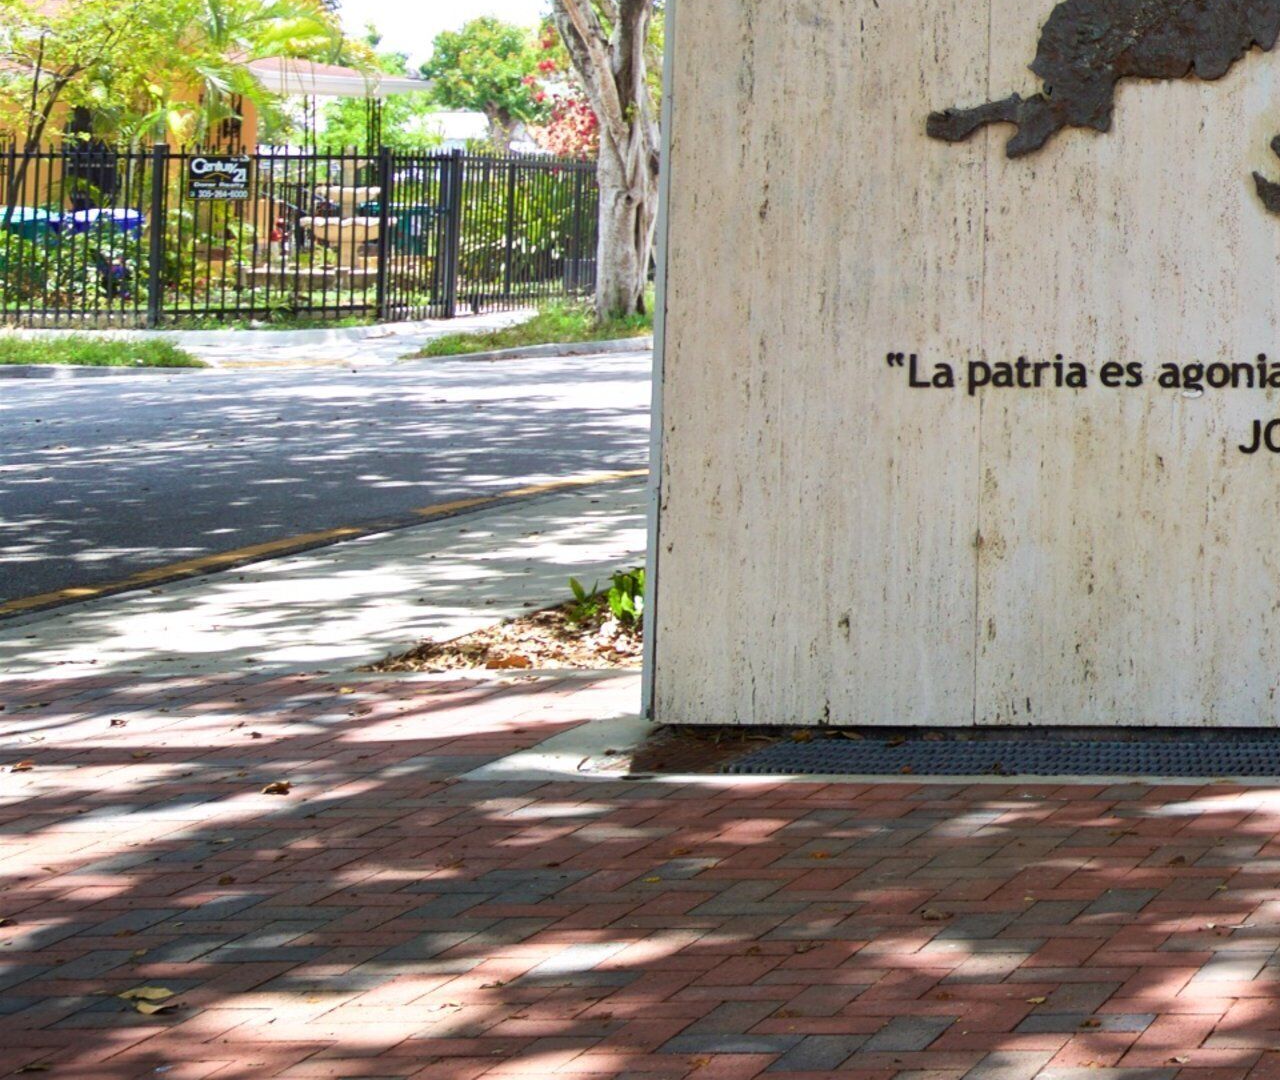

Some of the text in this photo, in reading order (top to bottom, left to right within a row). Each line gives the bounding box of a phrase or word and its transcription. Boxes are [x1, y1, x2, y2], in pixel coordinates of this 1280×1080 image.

[191, 157, 239, 174] Century
[232, 168, 247, 183] 21
[886, 351, 955, 388] “La
[968, 353, 1088, 396] patria
[1099, 362, 1144, 388] es
